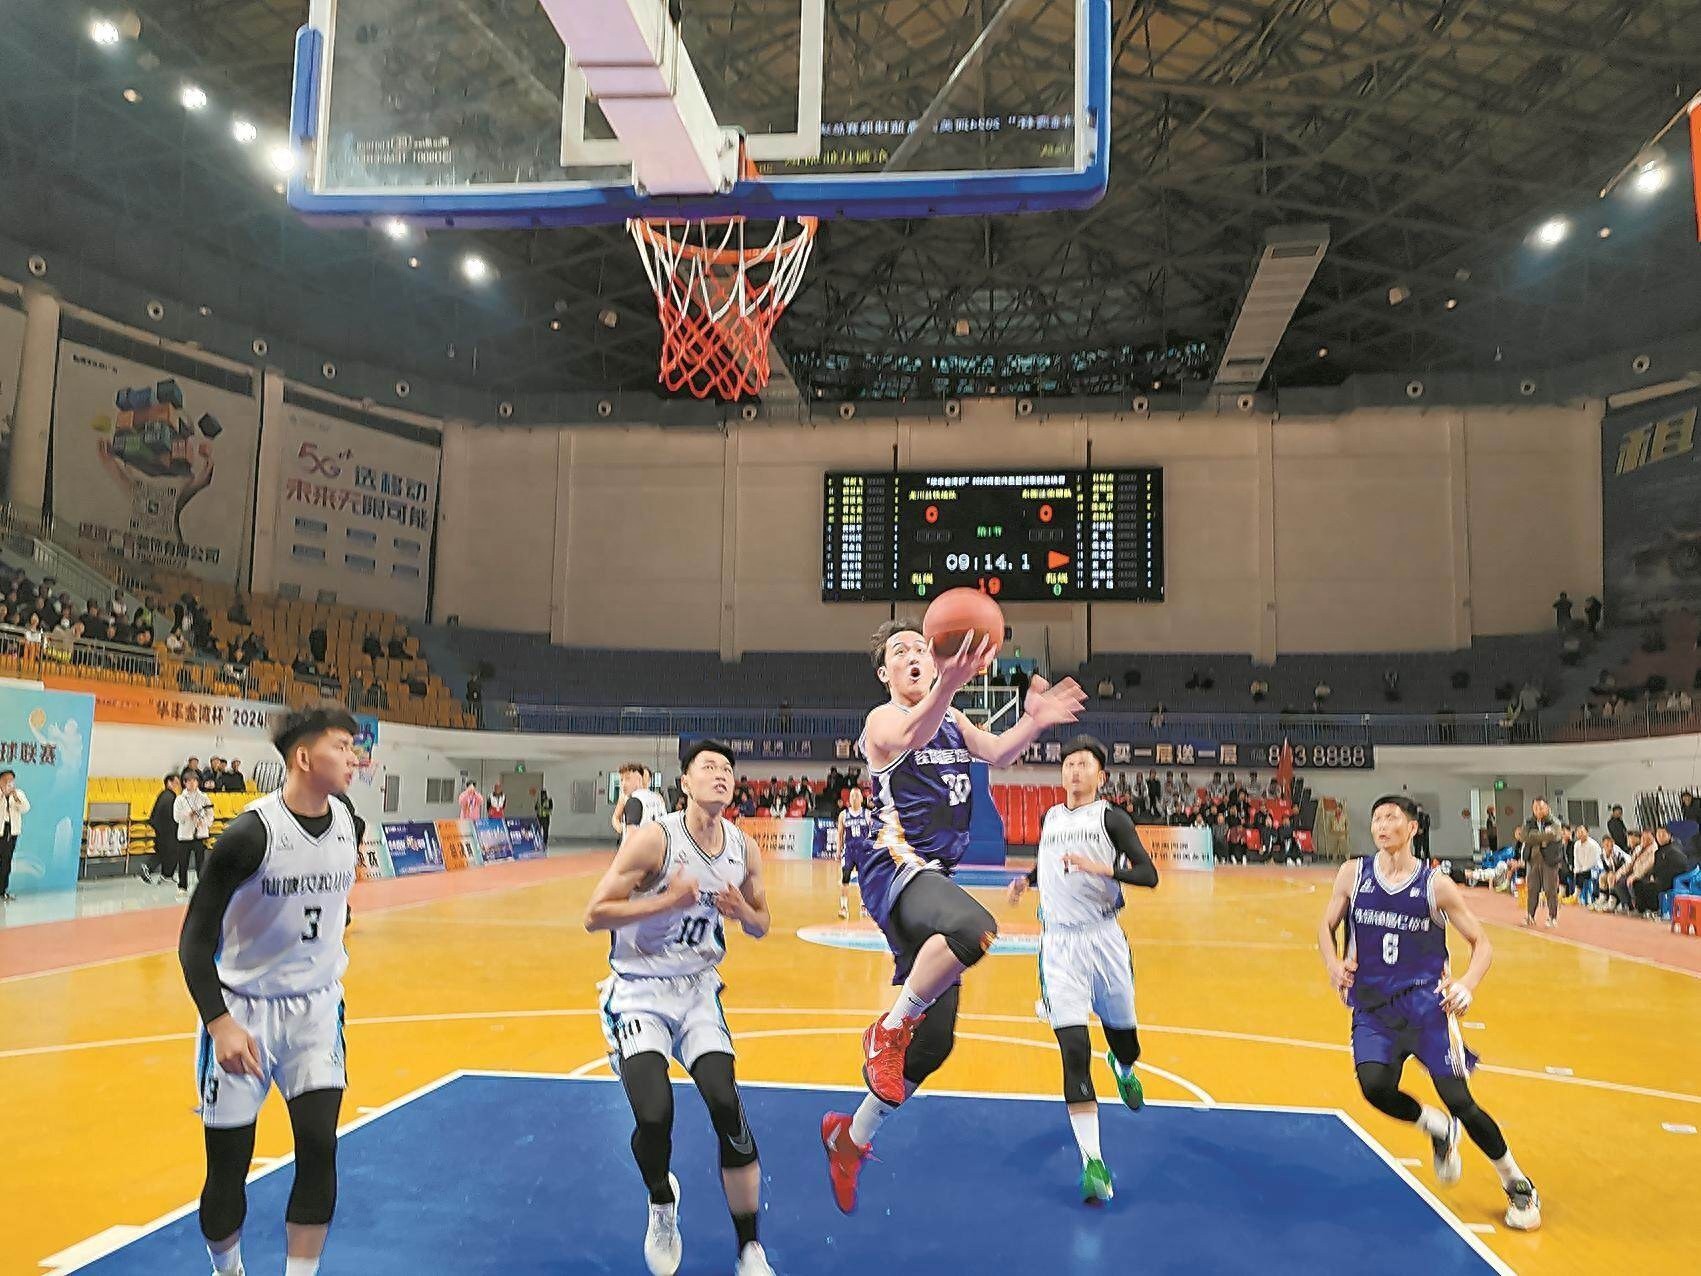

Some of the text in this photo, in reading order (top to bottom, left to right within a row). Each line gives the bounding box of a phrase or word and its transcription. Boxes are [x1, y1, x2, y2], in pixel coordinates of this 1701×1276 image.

[925, 506, 939, 523] 0
[1039, 504, 1053, 523] 0
[1268, 743, 1307, 767] 83
[1313, 743, 1366, 767] 8888
[301, 904, 322, 943] 3
